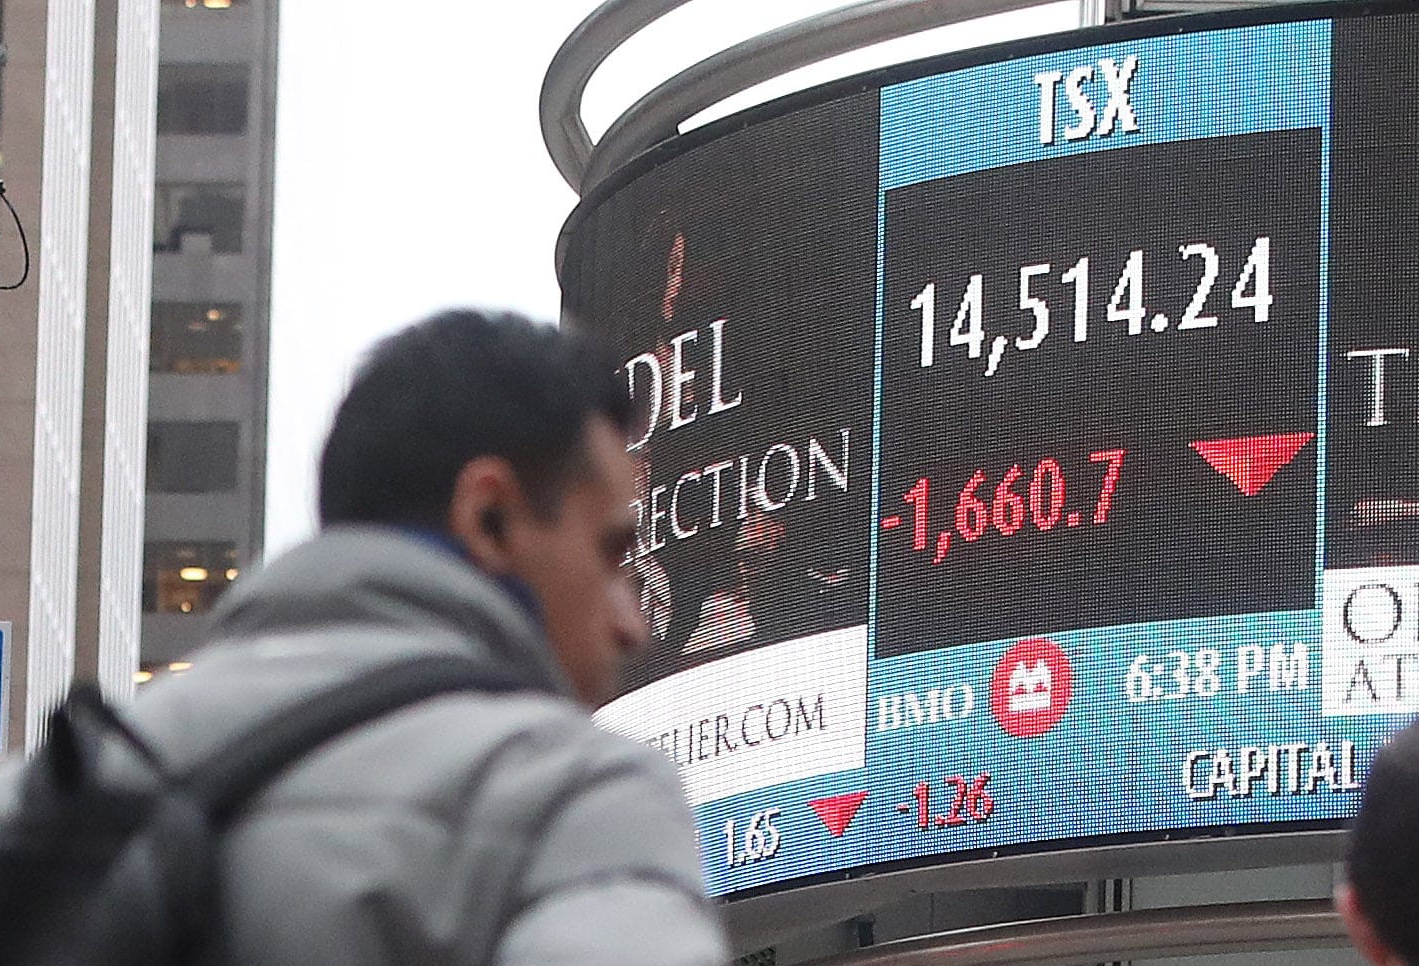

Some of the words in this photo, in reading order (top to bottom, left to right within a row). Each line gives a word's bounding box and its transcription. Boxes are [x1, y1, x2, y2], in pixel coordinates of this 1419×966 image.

[1034, 56, 1141, 146] TSX
[909, 236, 1274, 377] 14,514.24
[614, 318, 742, 453] DEL
[1340, 348, 1419, 427] T
[881, 448, 1130, 565] -1,660.7
[1343, 582, 1419, 645] O
[875, 683, 974, 732] BMO
[1125, 646, 1222, 702] 6:38
[1236, 641, 1310, 694] PM
[645, 692, 828, 765] ELIER.COM
[896, 770, 995, 831] -1.26
[1183, 739, 1363, 801] CAPITAL
